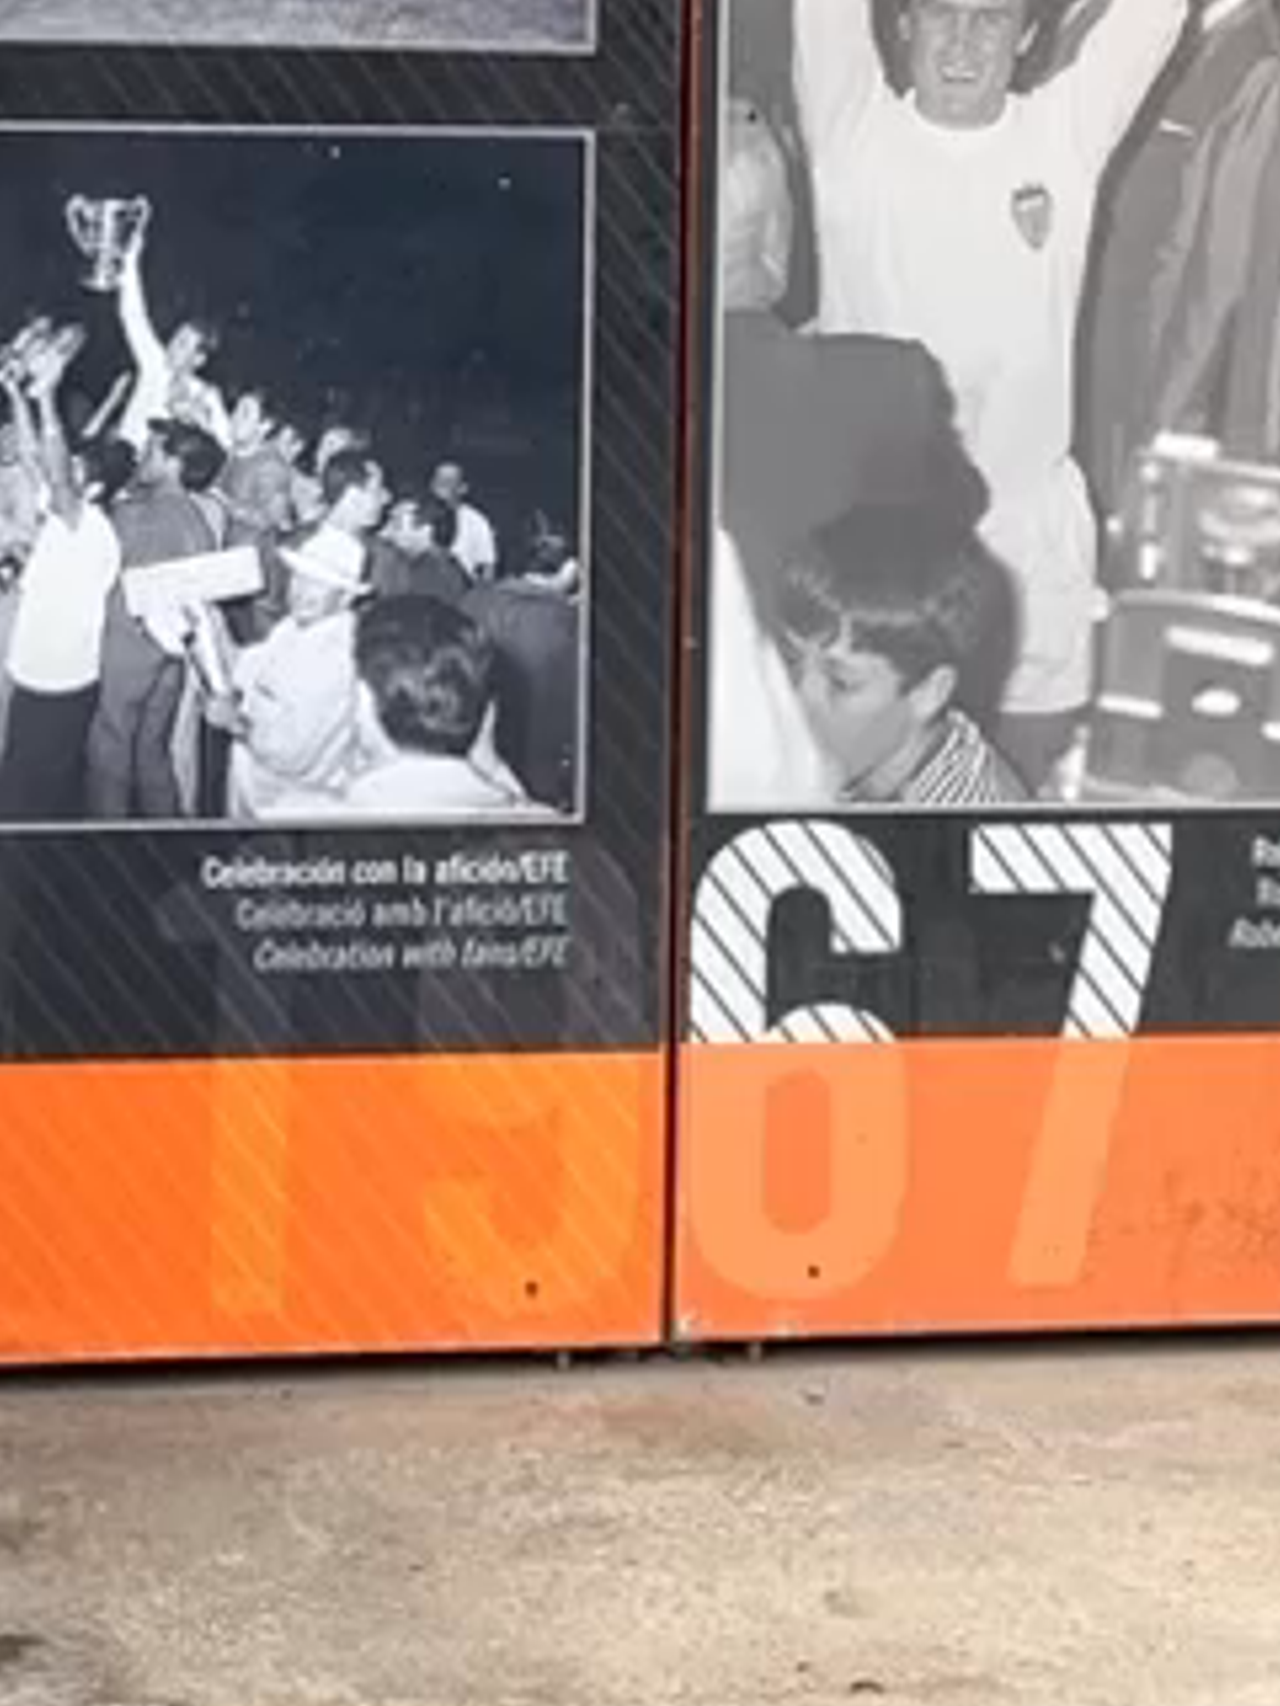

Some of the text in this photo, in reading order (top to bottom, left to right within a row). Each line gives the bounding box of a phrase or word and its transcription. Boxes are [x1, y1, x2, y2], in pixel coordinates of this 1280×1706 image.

[201, 853, 347, 887] Celebración
[351, 855, 397, 884] con
[404, 853, 426, 883] la
[373, 896, 427, 927] amb
[253, 940, 394, 972] Celebration
[403, 939, 457, 969] with
